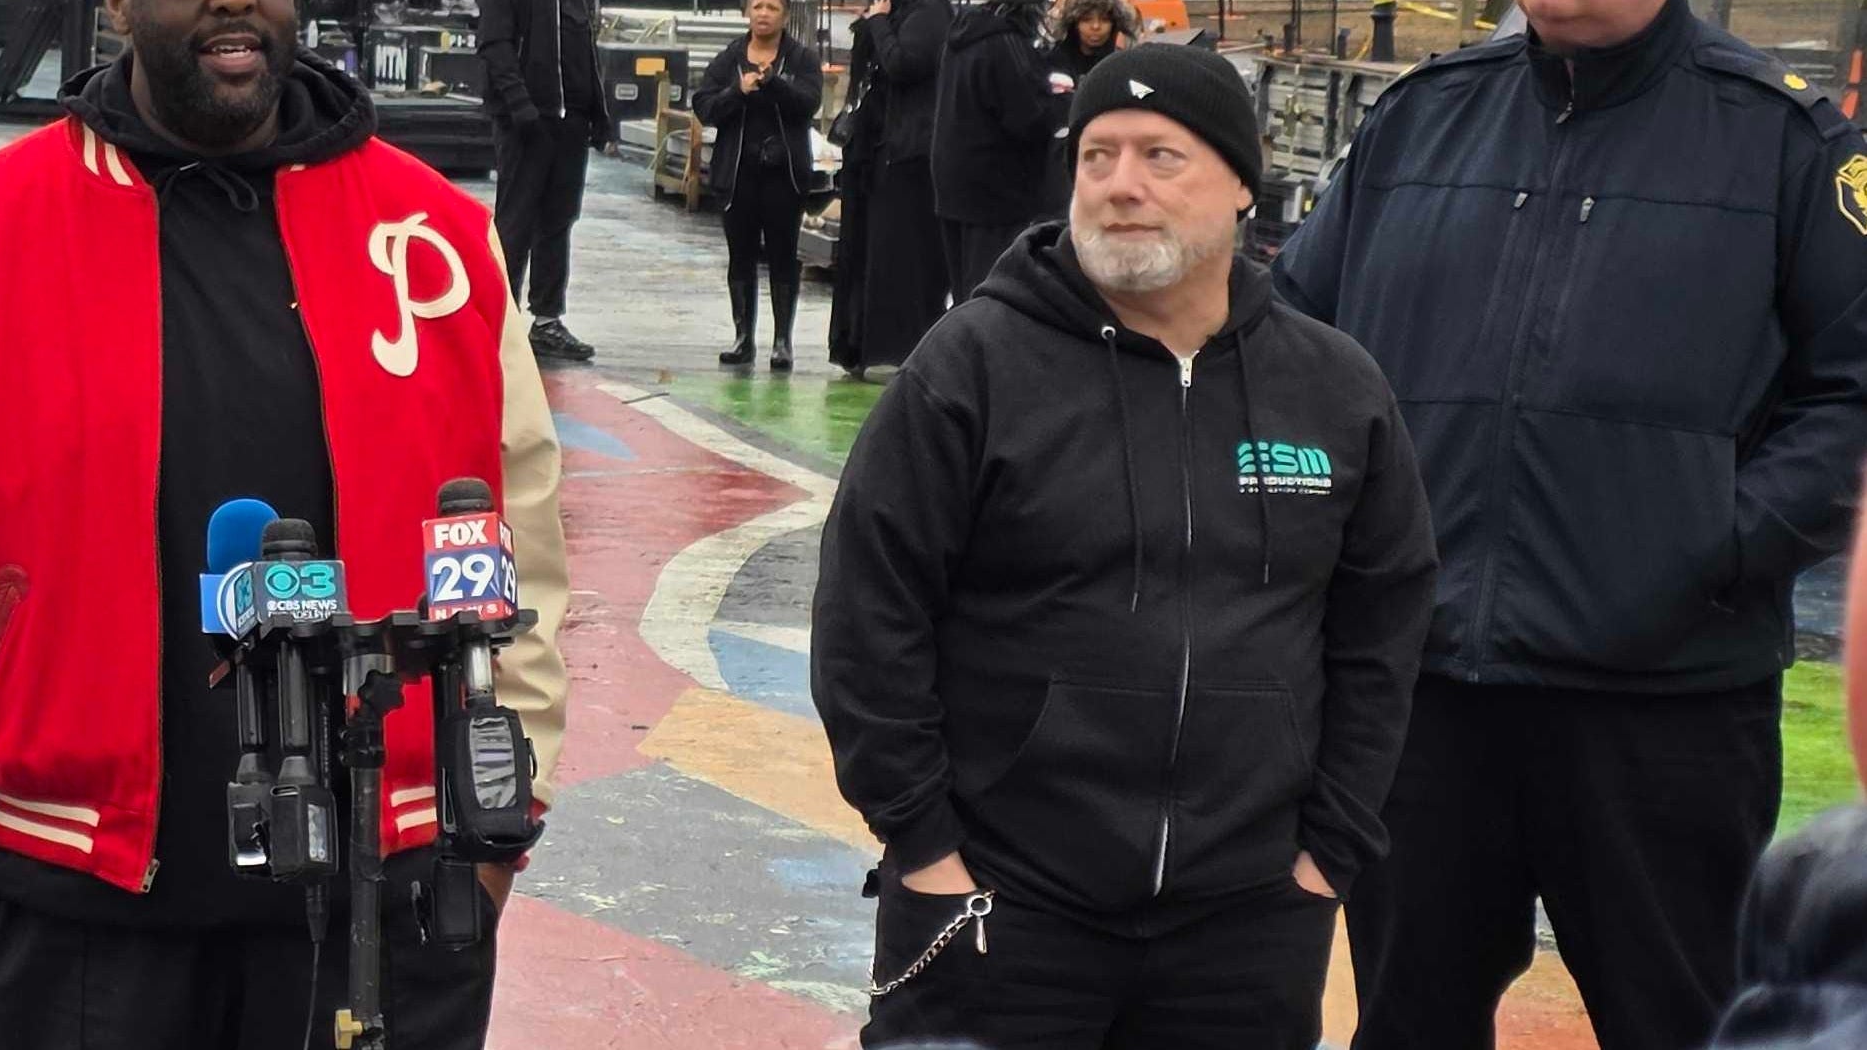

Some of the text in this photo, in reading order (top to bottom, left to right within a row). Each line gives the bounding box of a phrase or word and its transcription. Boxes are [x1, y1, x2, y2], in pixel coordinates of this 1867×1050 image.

[368, 211, 471, 377] P
[1239, 476, 1332, 488] PRDUCTIONS
[434, 519, 488, 549] FOX
[300, 563, 336, 598] 3
[432, 553, 495, 602] 29
[278, 600, 338, 611] CBS NEWS
